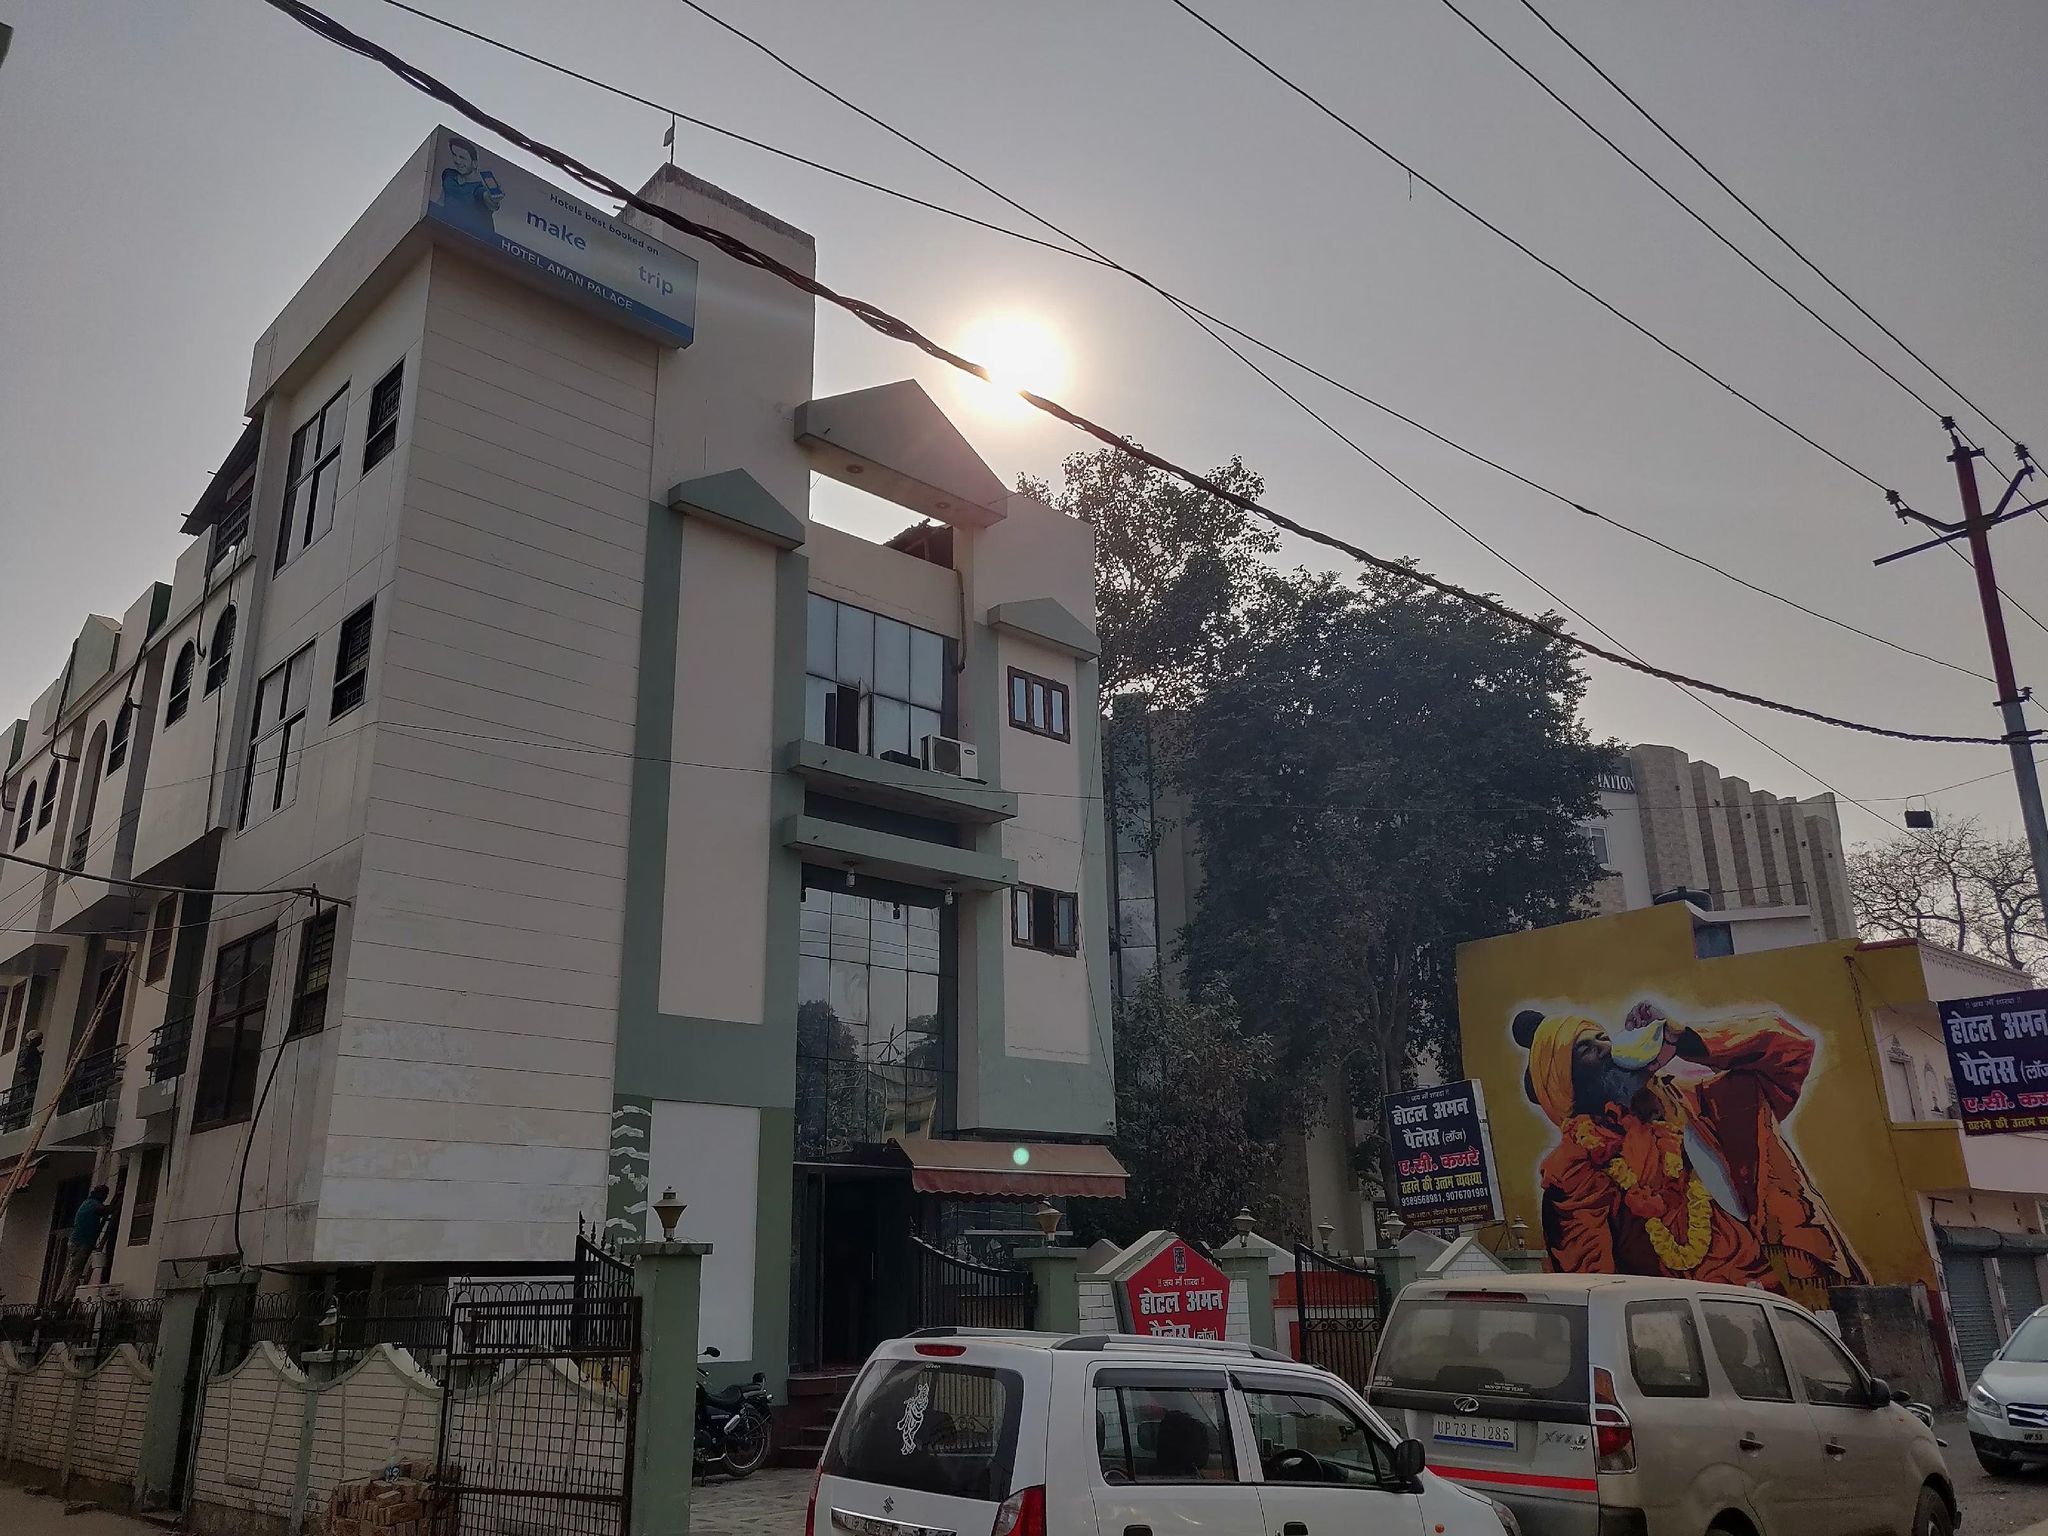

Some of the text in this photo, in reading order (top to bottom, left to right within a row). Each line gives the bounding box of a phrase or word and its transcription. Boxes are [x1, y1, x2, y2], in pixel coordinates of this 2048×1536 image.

[527, 210, 587, 251] make
[550, 193, 660, 256] Hotels best booked on
[501, 240, 633, 311] HOTEL AMAN PALACE
[638, 265, 674, 295] trip
[1947, 1009, 2048, 1045] होटल अमन
[1956, 1050, 2018, 1086] पैलेस
[1392, 1097, 1469, 1126] होटल अमन
[1962, 1089, 2015, 1113] ए.सी.
[1402, 1127, 1467, 1149] पैलेस (लॉज)
[1994, 1118, 2009, 1129] की
[1398, 1146, 1480, 1176] ए.सी. कमरे
[1401, 1177, 1421, 1195] ठहरने
[1422, 1175, 1433, 1192] की
[1435, 1175, 1454, 1191] उत्तम
[1139, 1288, 1223, 1315] होटल अमन
[1438, 1420, 1510, 1441] UP 73 E 1285
